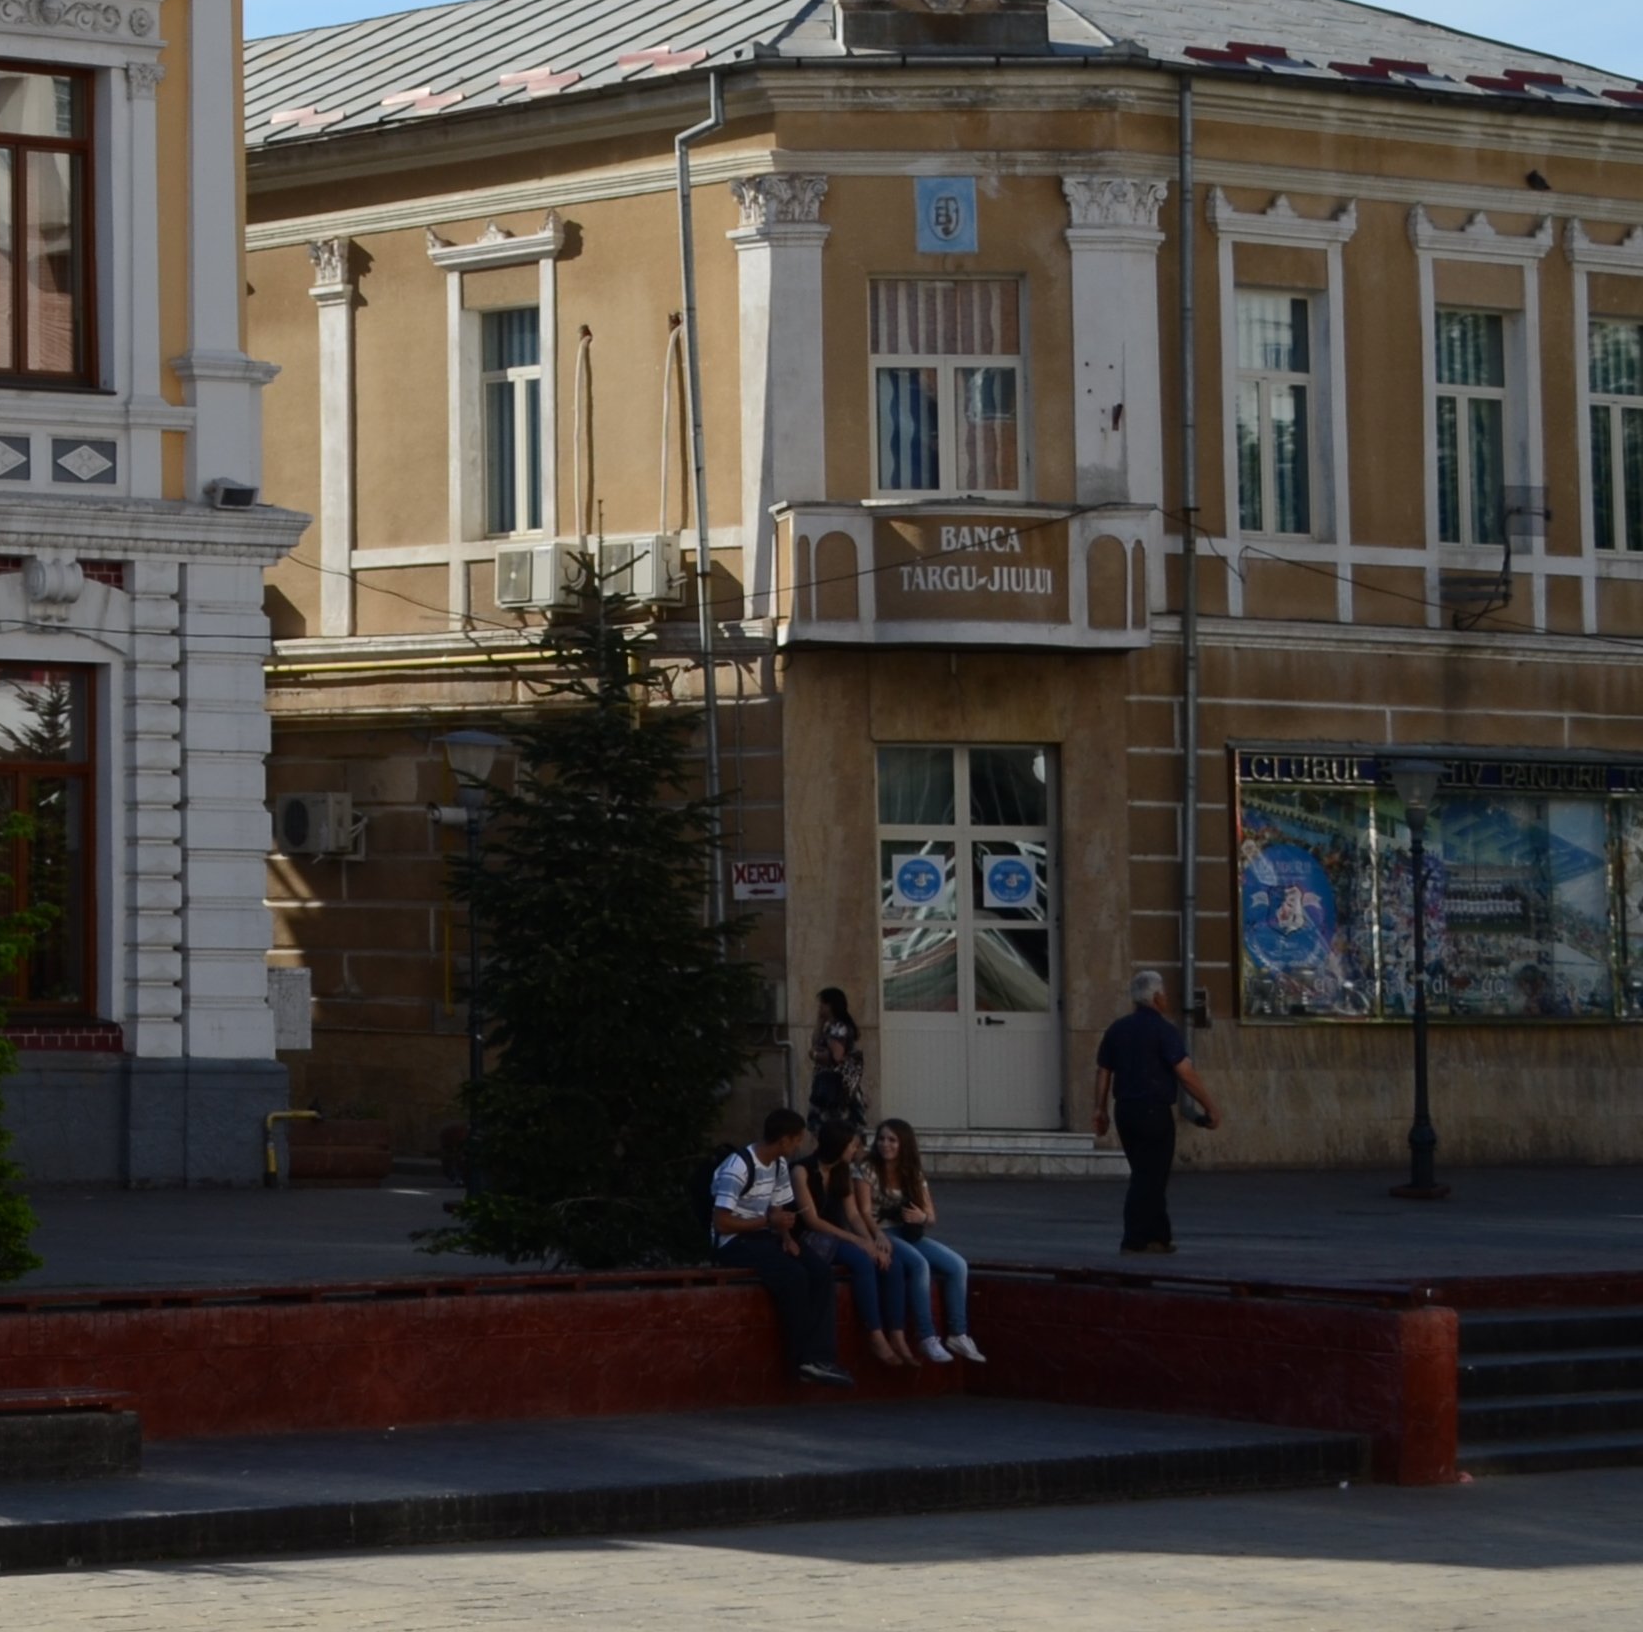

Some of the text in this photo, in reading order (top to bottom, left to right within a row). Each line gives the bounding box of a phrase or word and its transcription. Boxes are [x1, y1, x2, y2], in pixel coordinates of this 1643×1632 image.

[940, 525, 1022, 553] BANCA
[1250, 755, 1370, 784] CLUBUL
[1500, 763, 1606, 791] PANDURII
